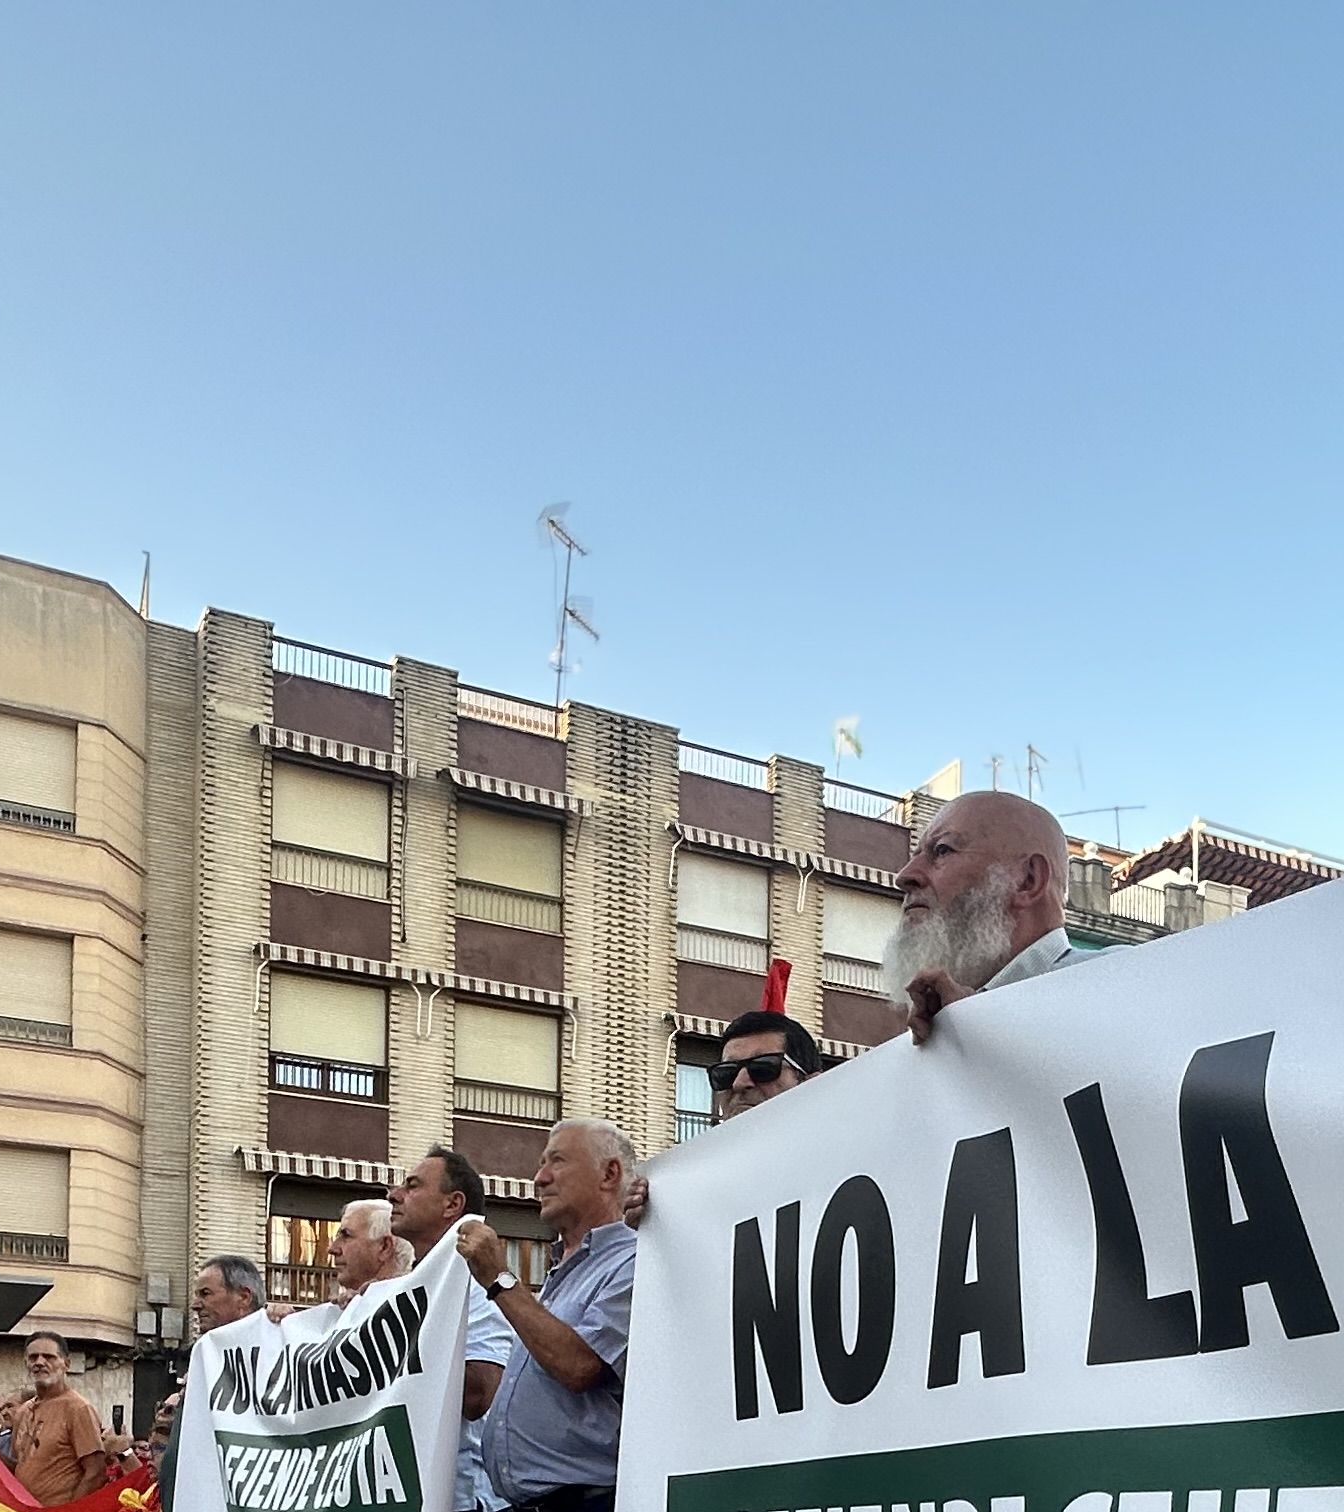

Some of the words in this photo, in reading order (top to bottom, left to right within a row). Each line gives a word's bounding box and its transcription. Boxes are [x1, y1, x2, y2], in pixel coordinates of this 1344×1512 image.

[734, 1173, 897, 1422] NO
[927, 1126, 1026, 1390] A
[1063, 1031, 1341, 1366] LA
[209, 1345, 251, 1416] NO
[313, 1424, 408, 1510] CEUTA
